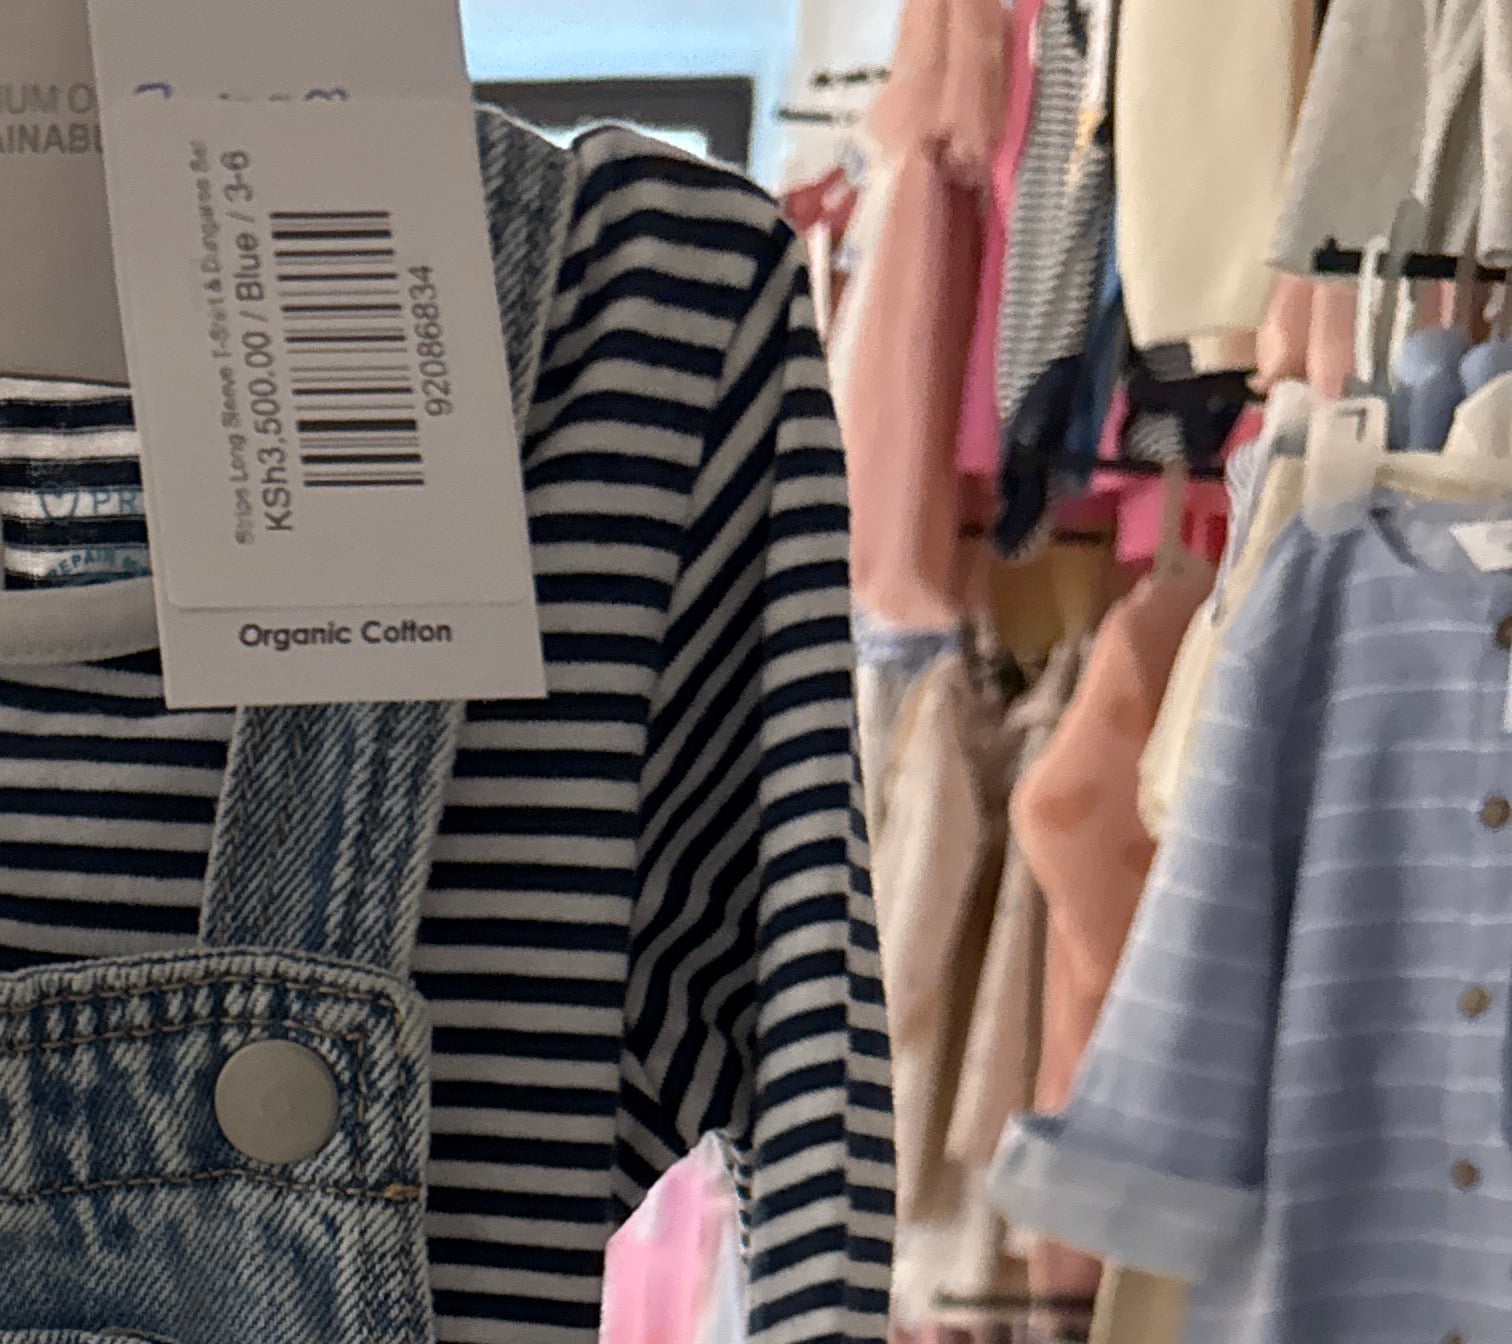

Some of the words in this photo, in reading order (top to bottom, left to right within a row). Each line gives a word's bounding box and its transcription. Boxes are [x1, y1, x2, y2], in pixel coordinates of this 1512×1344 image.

[67, 81, 97, 116] O
[220, 149, 254, 203] 3-6
[234, 232, 265, 302] Blue
[408, 265, 455, 417] 92086834
[239, 619, 353, 651] Organic
[360, 618, 454, 644] Cotton
